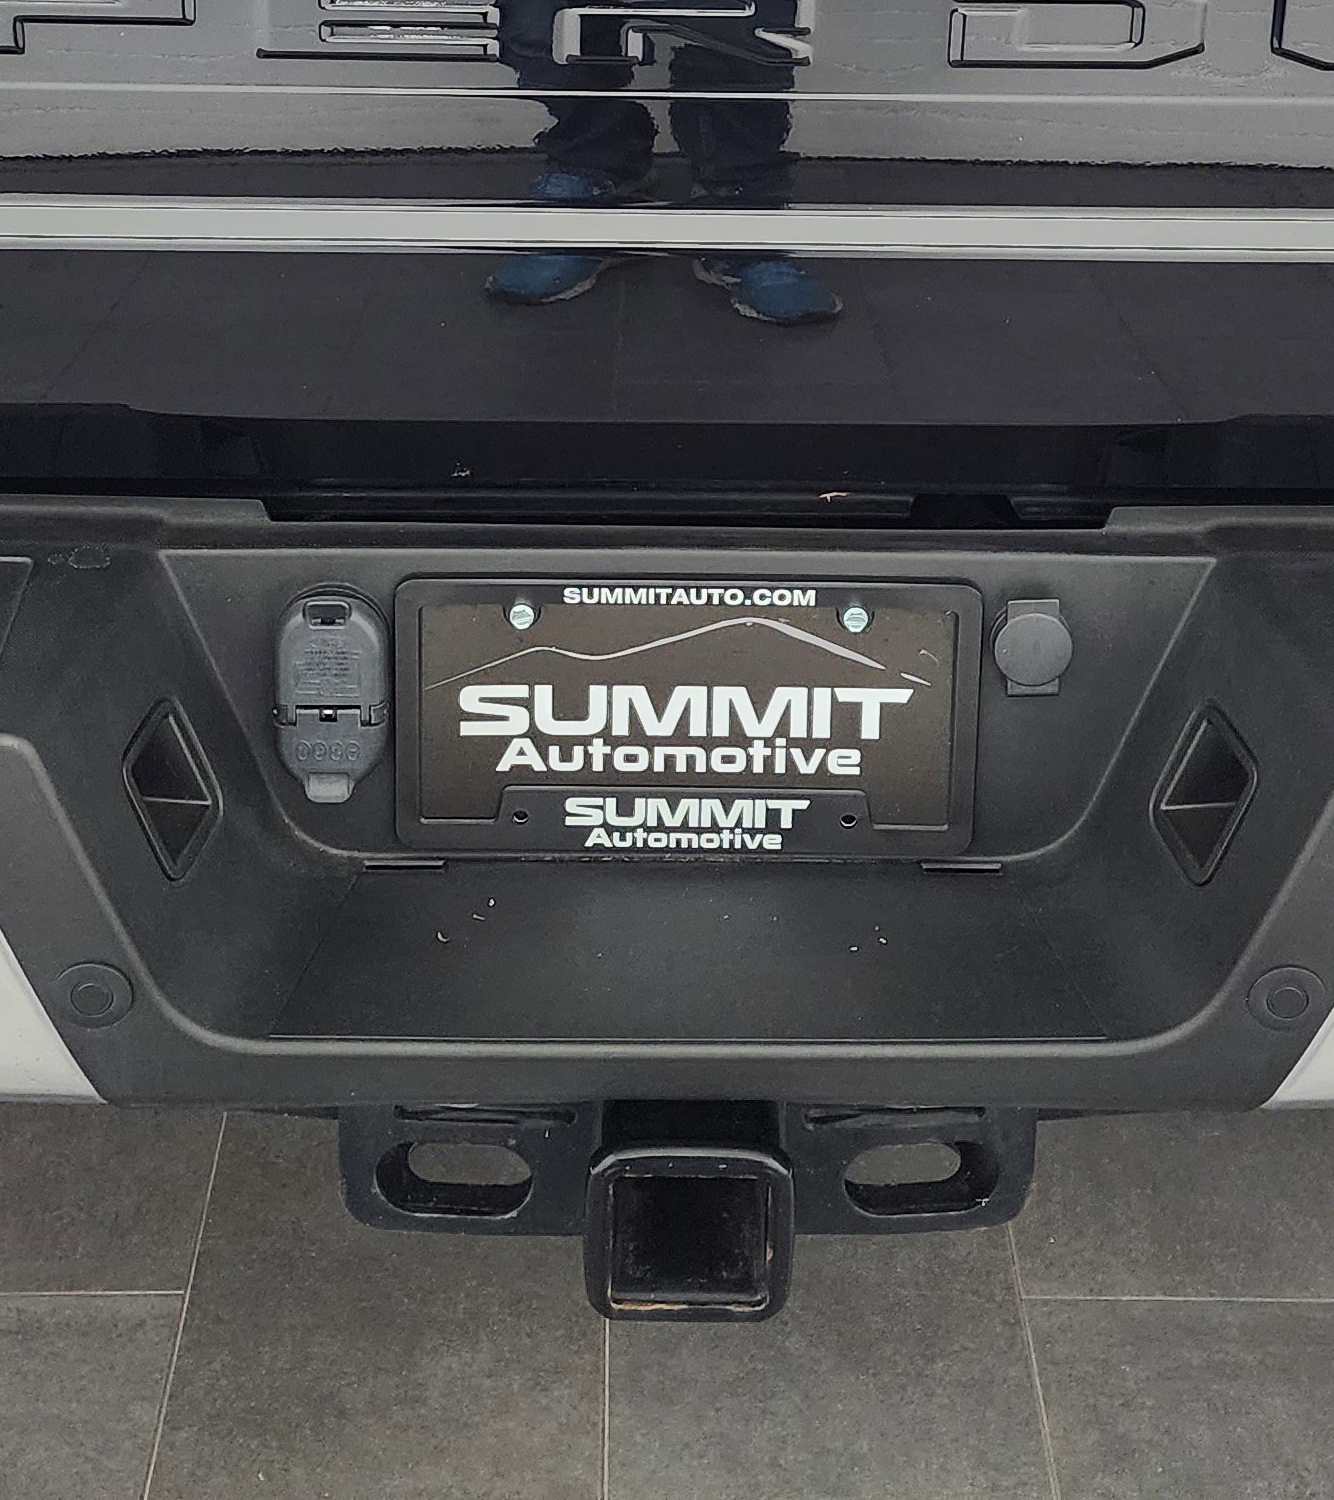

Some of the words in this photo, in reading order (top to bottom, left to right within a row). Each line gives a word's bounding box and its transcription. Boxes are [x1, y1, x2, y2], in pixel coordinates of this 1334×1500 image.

[563, 587, 817, 606] SUMMITAUTO.COM
[459, 684, 915, 739] SUMMIT
[495, 737, 861, 775] Automotive
[564, 796, 811, 829] SUMMIT
[584, 826, 783, 850] Automotive
